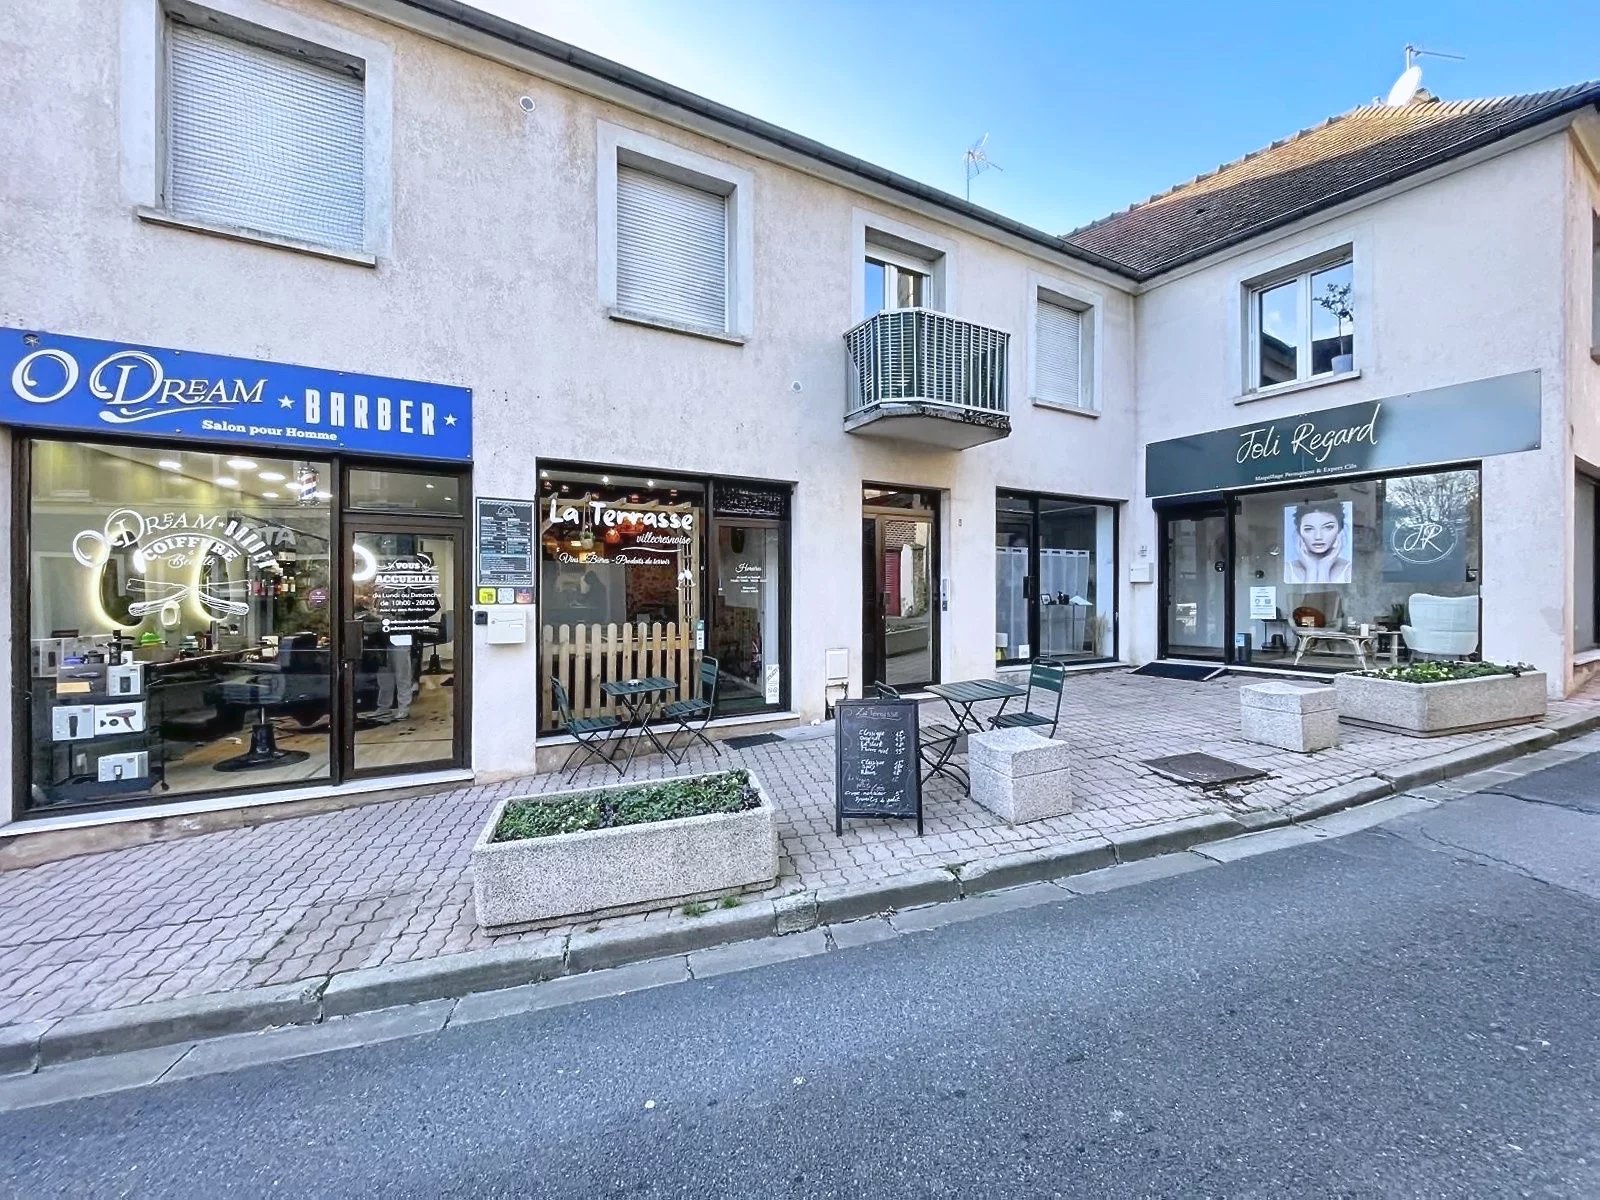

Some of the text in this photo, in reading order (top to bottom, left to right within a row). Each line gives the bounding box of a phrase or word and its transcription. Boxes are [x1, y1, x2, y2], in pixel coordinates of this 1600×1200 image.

[11, 349, 79, 403] O
[305, 388, 435, 436] BARBER
[201, 419, 338, 441] Salon pour Homme
[1236, 403, 1381, 464] Joli Regard
[550, 499, 694, 531] La Terrasse
[636, 531, 691, 545] villecresnoise
[395, 562, 421, 570] VOUS
[375, 575, 439, 584] ACCUEILLE
